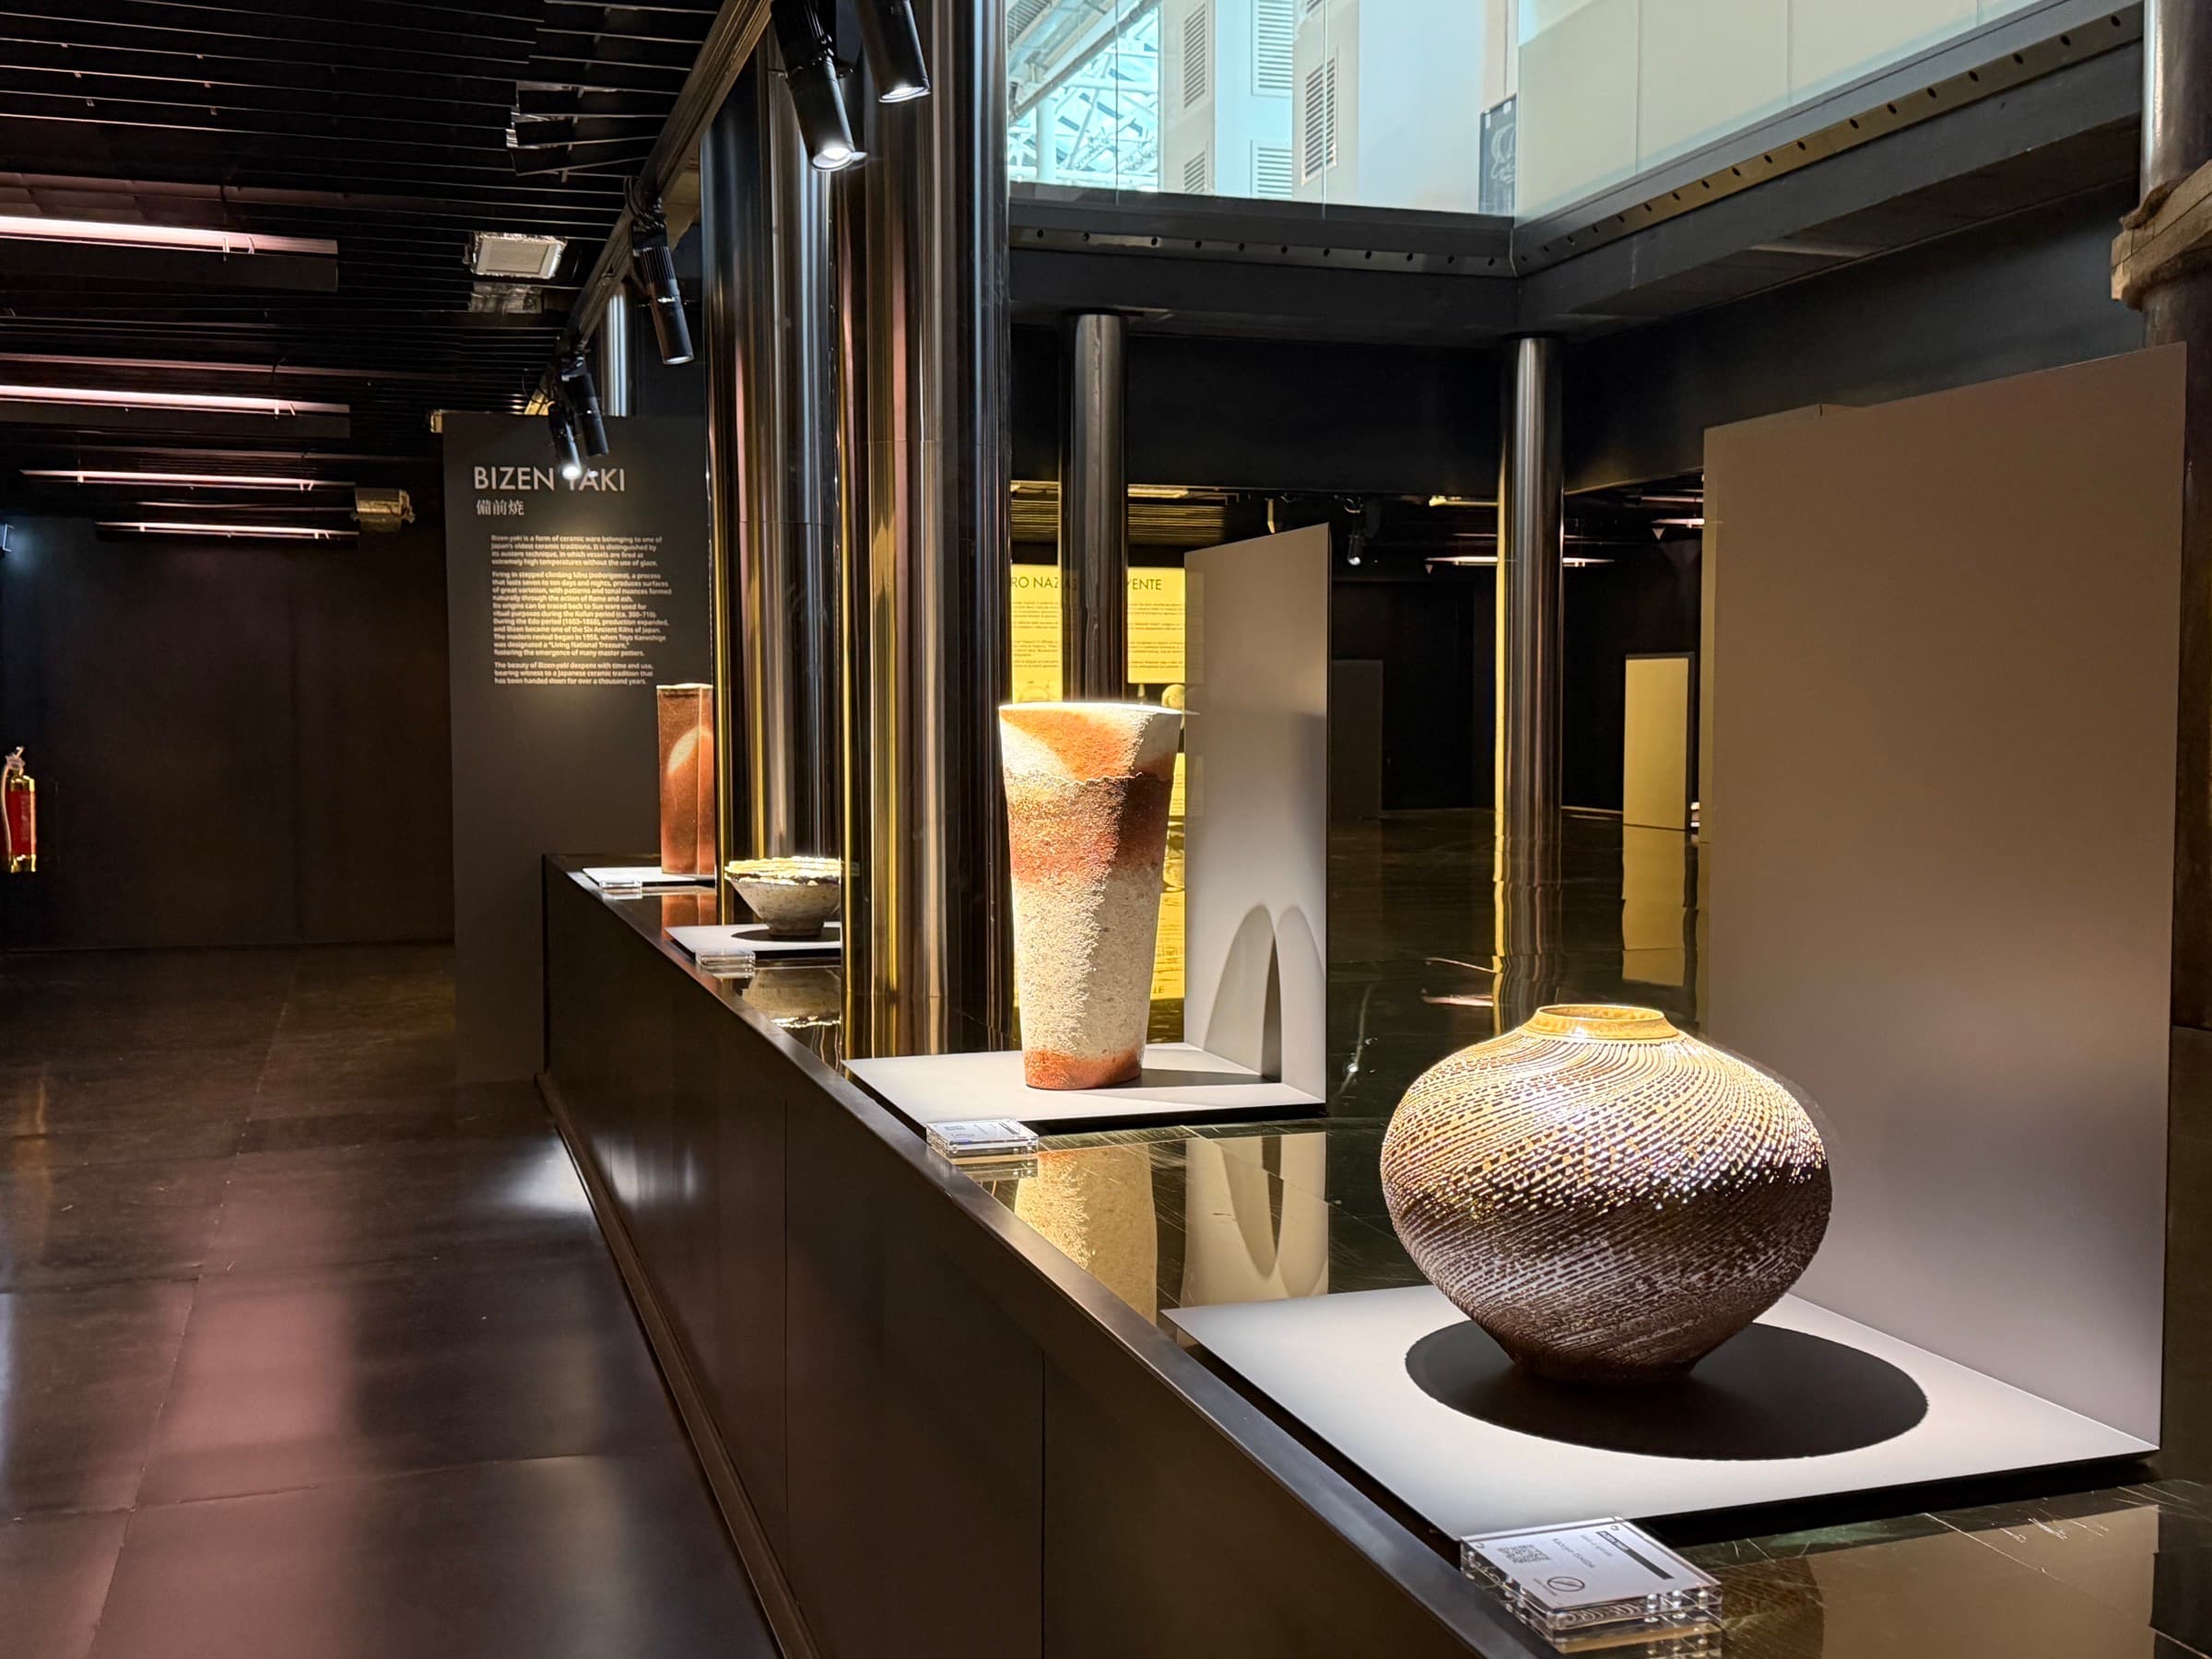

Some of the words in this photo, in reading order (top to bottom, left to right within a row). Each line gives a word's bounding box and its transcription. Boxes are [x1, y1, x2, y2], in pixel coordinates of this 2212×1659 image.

[474, 466, 555, 491] BIZEN
[649, 544, 656, 552] by
[1128, 578, 1162, 591] ENTE
